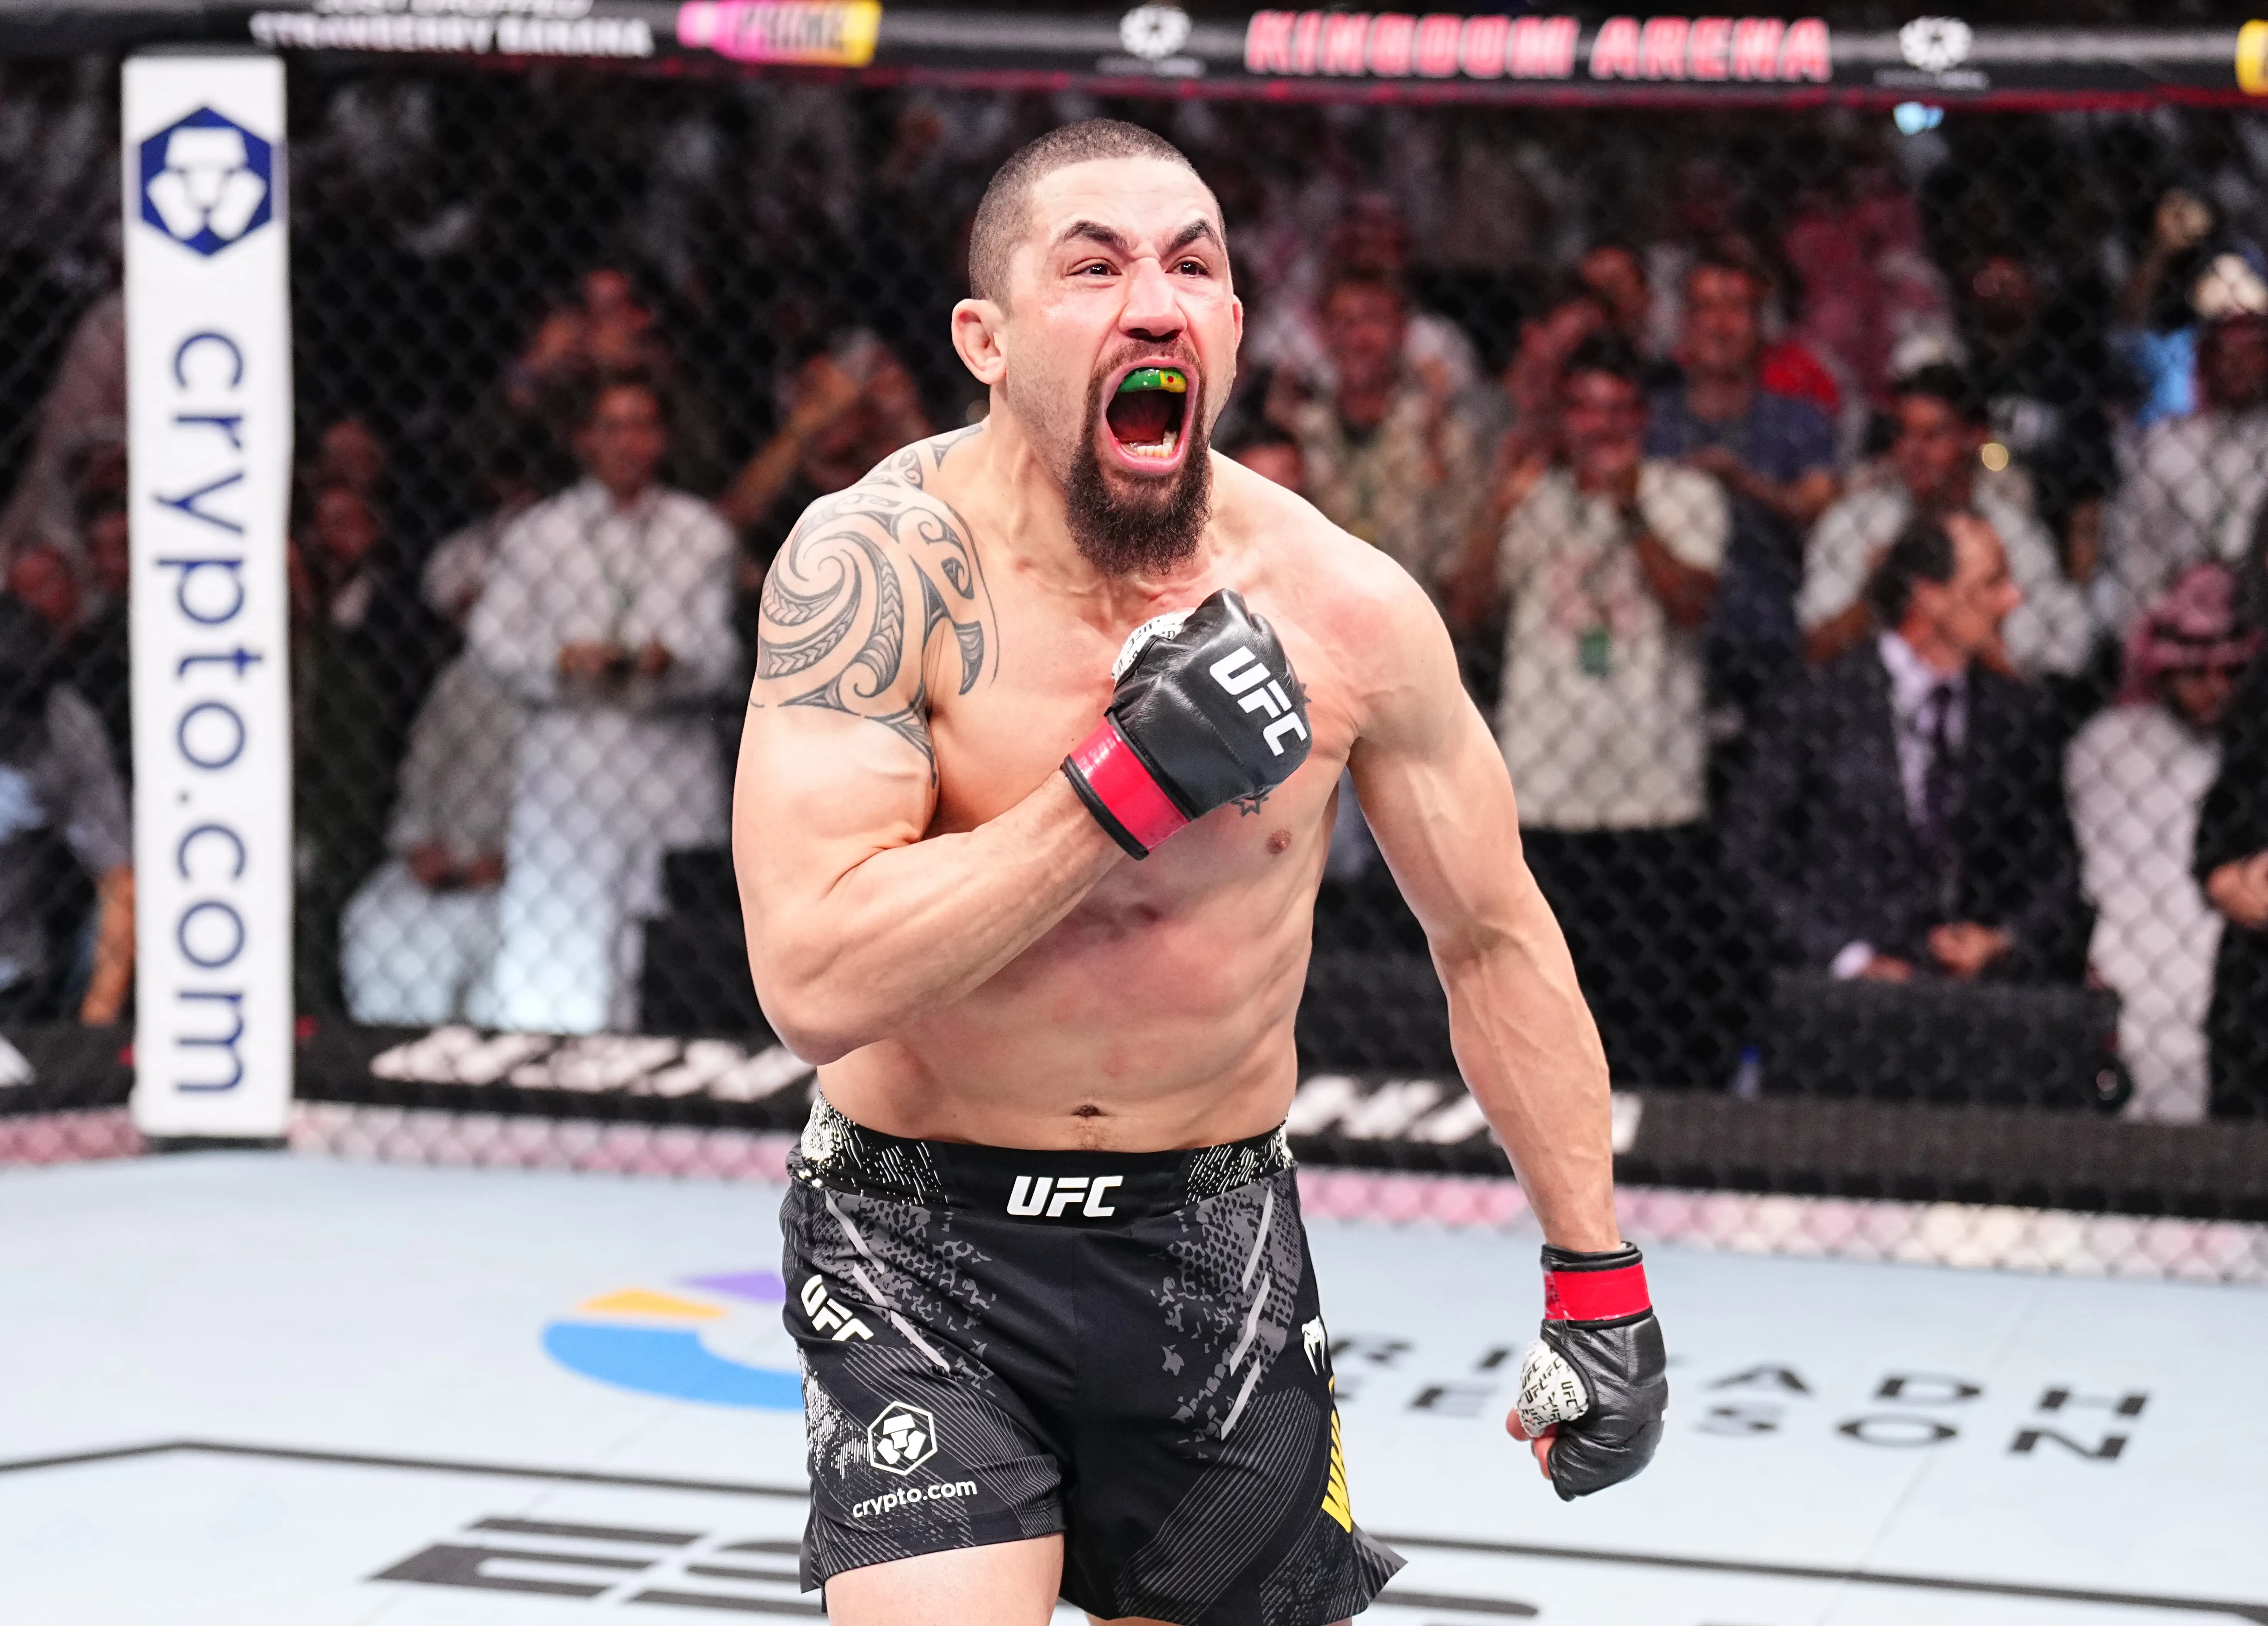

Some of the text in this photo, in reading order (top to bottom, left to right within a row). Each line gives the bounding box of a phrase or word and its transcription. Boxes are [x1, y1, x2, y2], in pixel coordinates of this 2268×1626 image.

[496, 16, 654, 57] BANANA
[1245, 10, 1831, 82] KINGDOM ARENA
[154, 330, 265, 1093] crypto.com
[1209, 646, 1307, 757] UFC
[1006, 1175, 1124, 1218] UFC
[1328, 1332, 2149, 1417] RIADH
[1561, 1381, 1578, 1408] UFC
[852, 1480, 978, 1519] crypto.com
